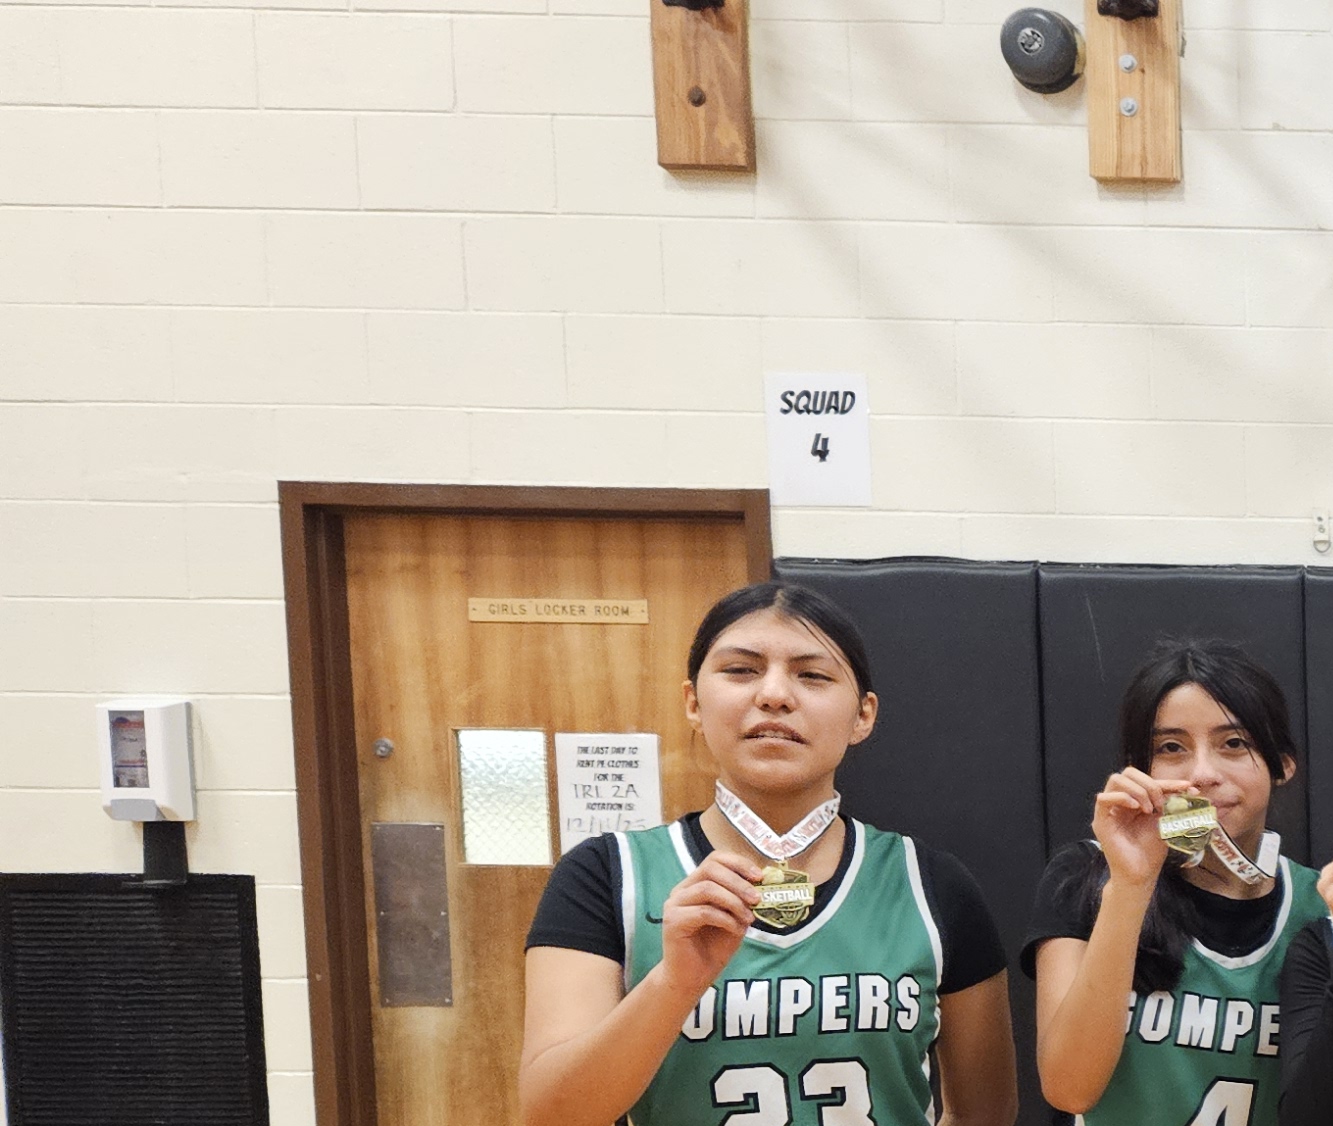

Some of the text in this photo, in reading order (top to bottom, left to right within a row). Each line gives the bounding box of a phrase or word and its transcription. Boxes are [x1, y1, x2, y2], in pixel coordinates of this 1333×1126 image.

[780, 390, 855, 415] SQUAD
[811, 433, 829, 462] 4
[488, 604, 630, 617] GIRLS LOCKER ROOM
[681, 973, 921, 1042] OMPERS
